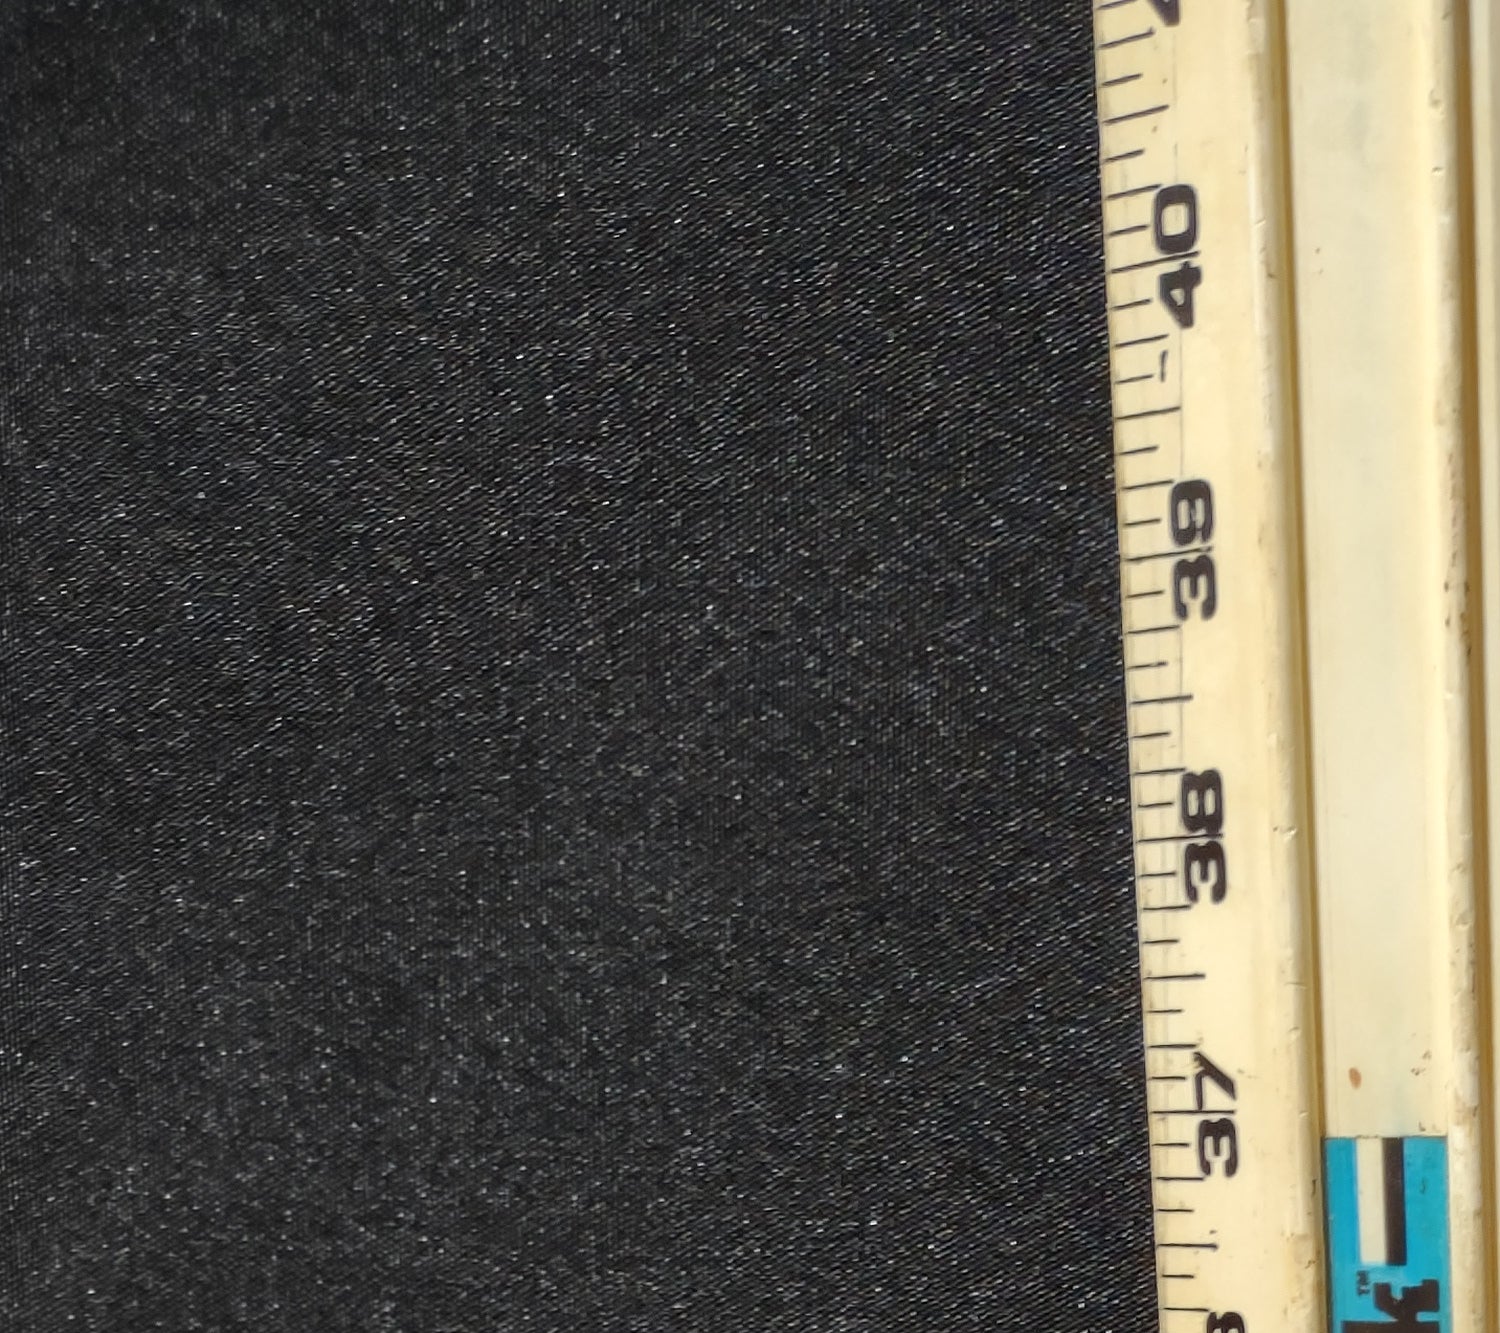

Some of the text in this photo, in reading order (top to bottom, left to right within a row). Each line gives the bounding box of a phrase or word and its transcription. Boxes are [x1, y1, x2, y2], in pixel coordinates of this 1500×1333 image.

[1152, 184, 1202, 329] 40
[1169, 479, 1217, 621] 39
[1180, 769, 1228, 903] 38
[1192, 1052, 1239, 1177] 37
